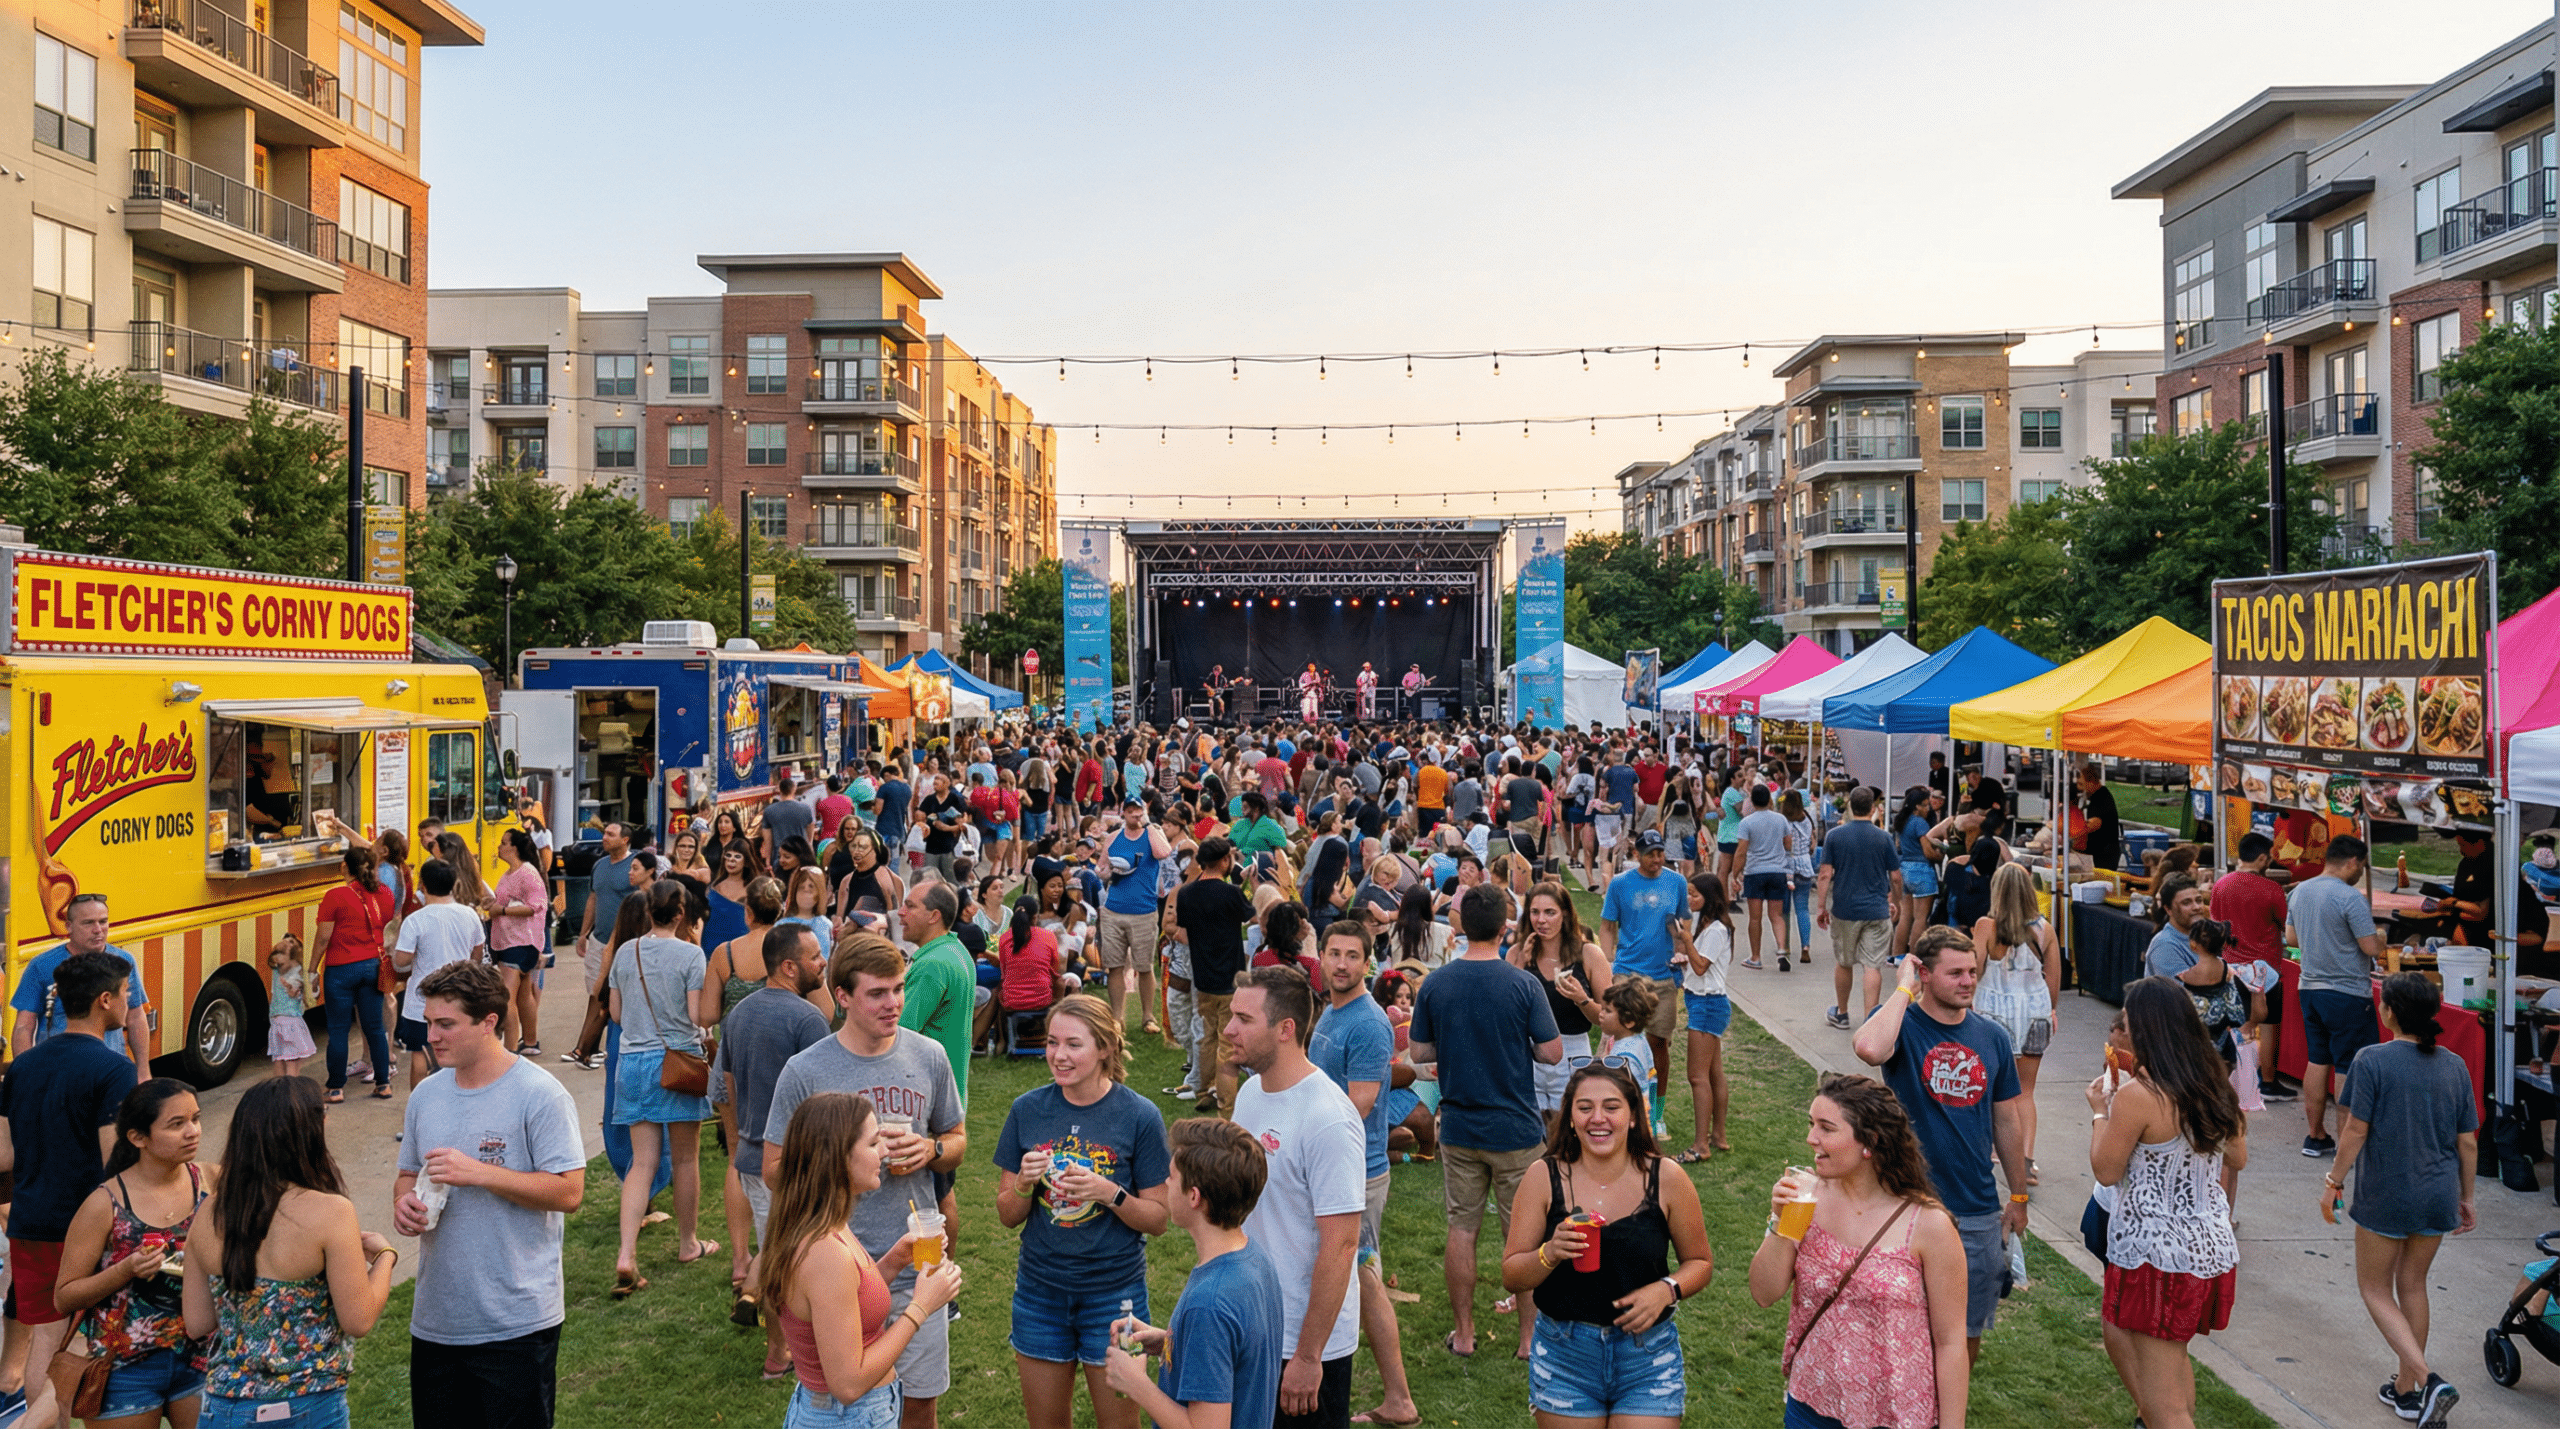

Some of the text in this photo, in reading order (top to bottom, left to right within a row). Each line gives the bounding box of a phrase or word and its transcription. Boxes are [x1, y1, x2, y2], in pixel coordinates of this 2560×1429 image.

[30, 577, 401, 643] FLETCHER'S CORNY DOGS
[2221, 577, 2478, 662] TACOS MARIACHI
[50, 719, 194, 821] Fletcher's
[100, 811, 194, 846] CORNY DOGS
[858, 1086, 925, 1121] RCOT
